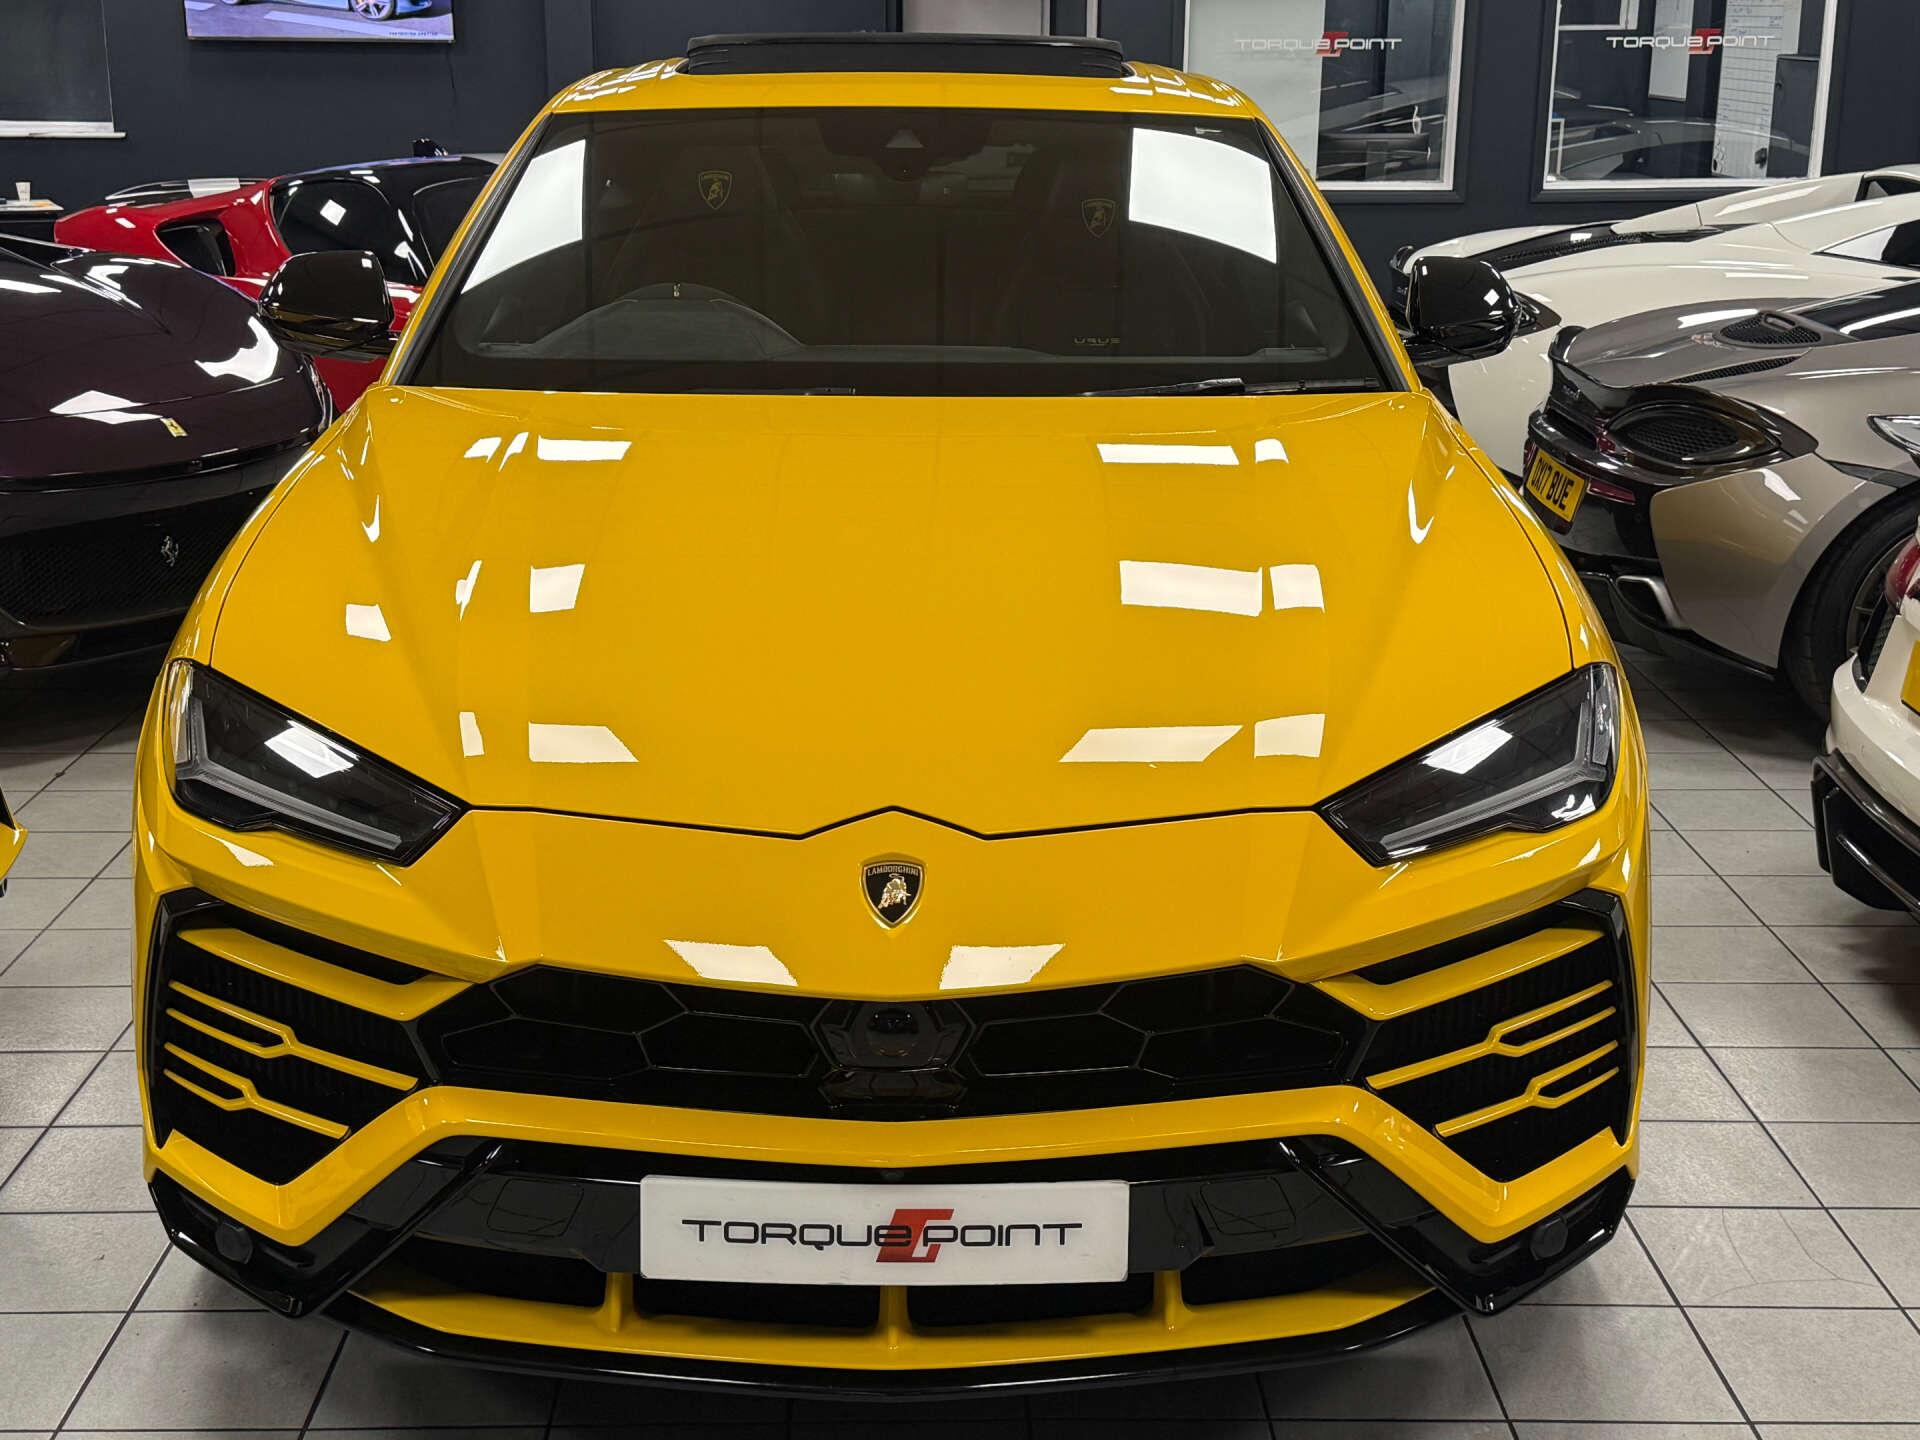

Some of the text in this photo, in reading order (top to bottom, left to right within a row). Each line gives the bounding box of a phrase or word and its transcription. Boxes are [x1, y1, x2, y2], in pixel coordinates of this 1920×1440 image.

[1234, 38, 1402, 52] TORQUE POINT
[1606, 35, 1776, 49] TORQUE POINT
[1546, 470, 1575, 511] BUE
[682, 1219, 1083, 1250] TORQUE POINT
